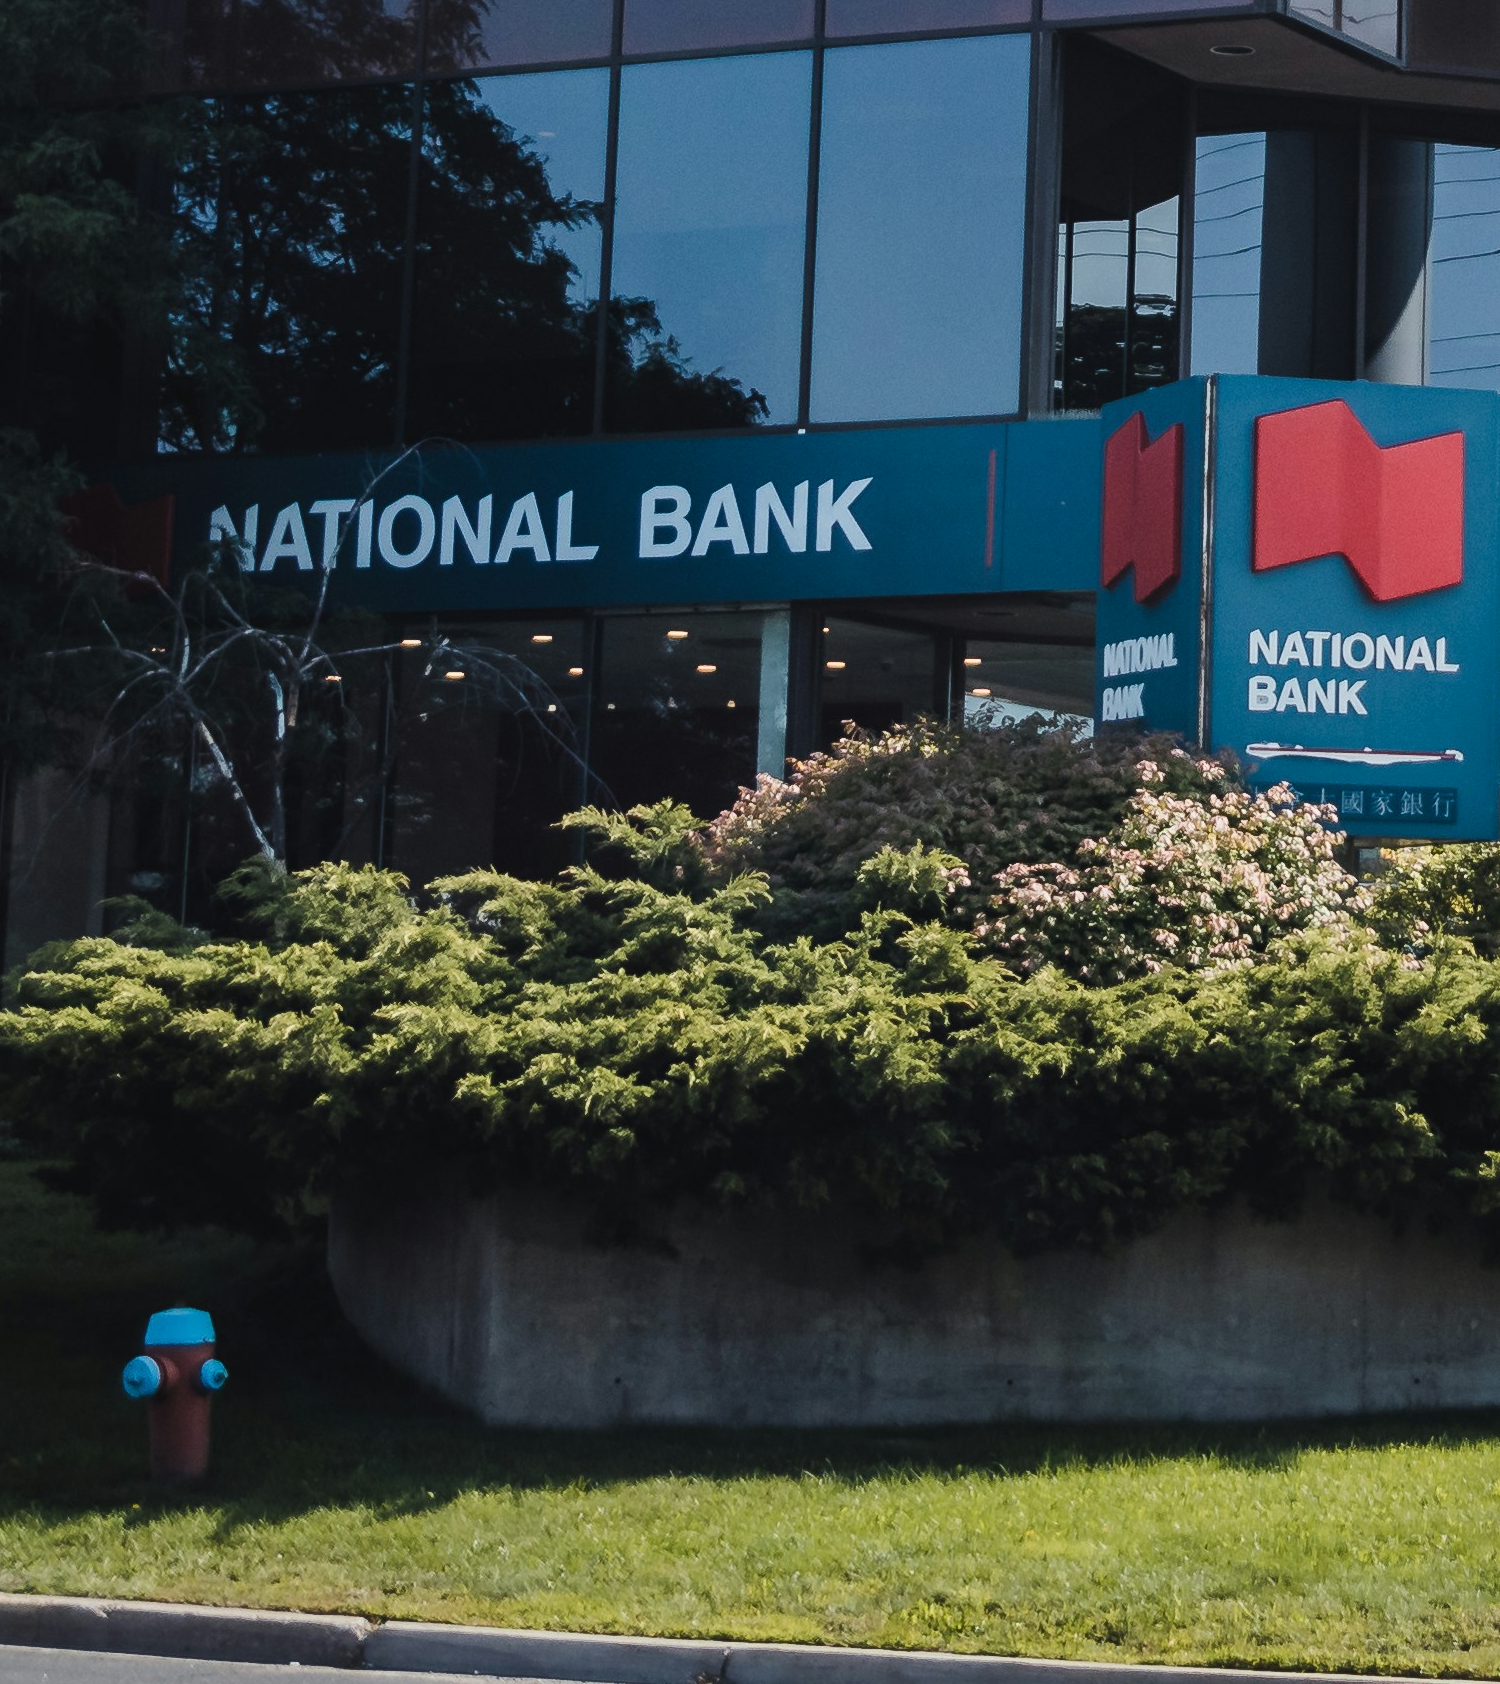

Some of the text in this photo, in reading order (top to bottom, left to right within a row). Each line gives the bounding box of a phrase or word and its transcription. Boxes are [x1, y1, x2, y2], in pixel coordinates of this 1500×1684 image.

[209, 477, 873, 572] NATIONAL BANK
[1104, 632, 1178, 677] NATIONAL
[1247, 628, 1460, 674] NATIONAL
[1102, 683, 1145, 722] BANK
[1247, 674, 1368, 716] BANK
